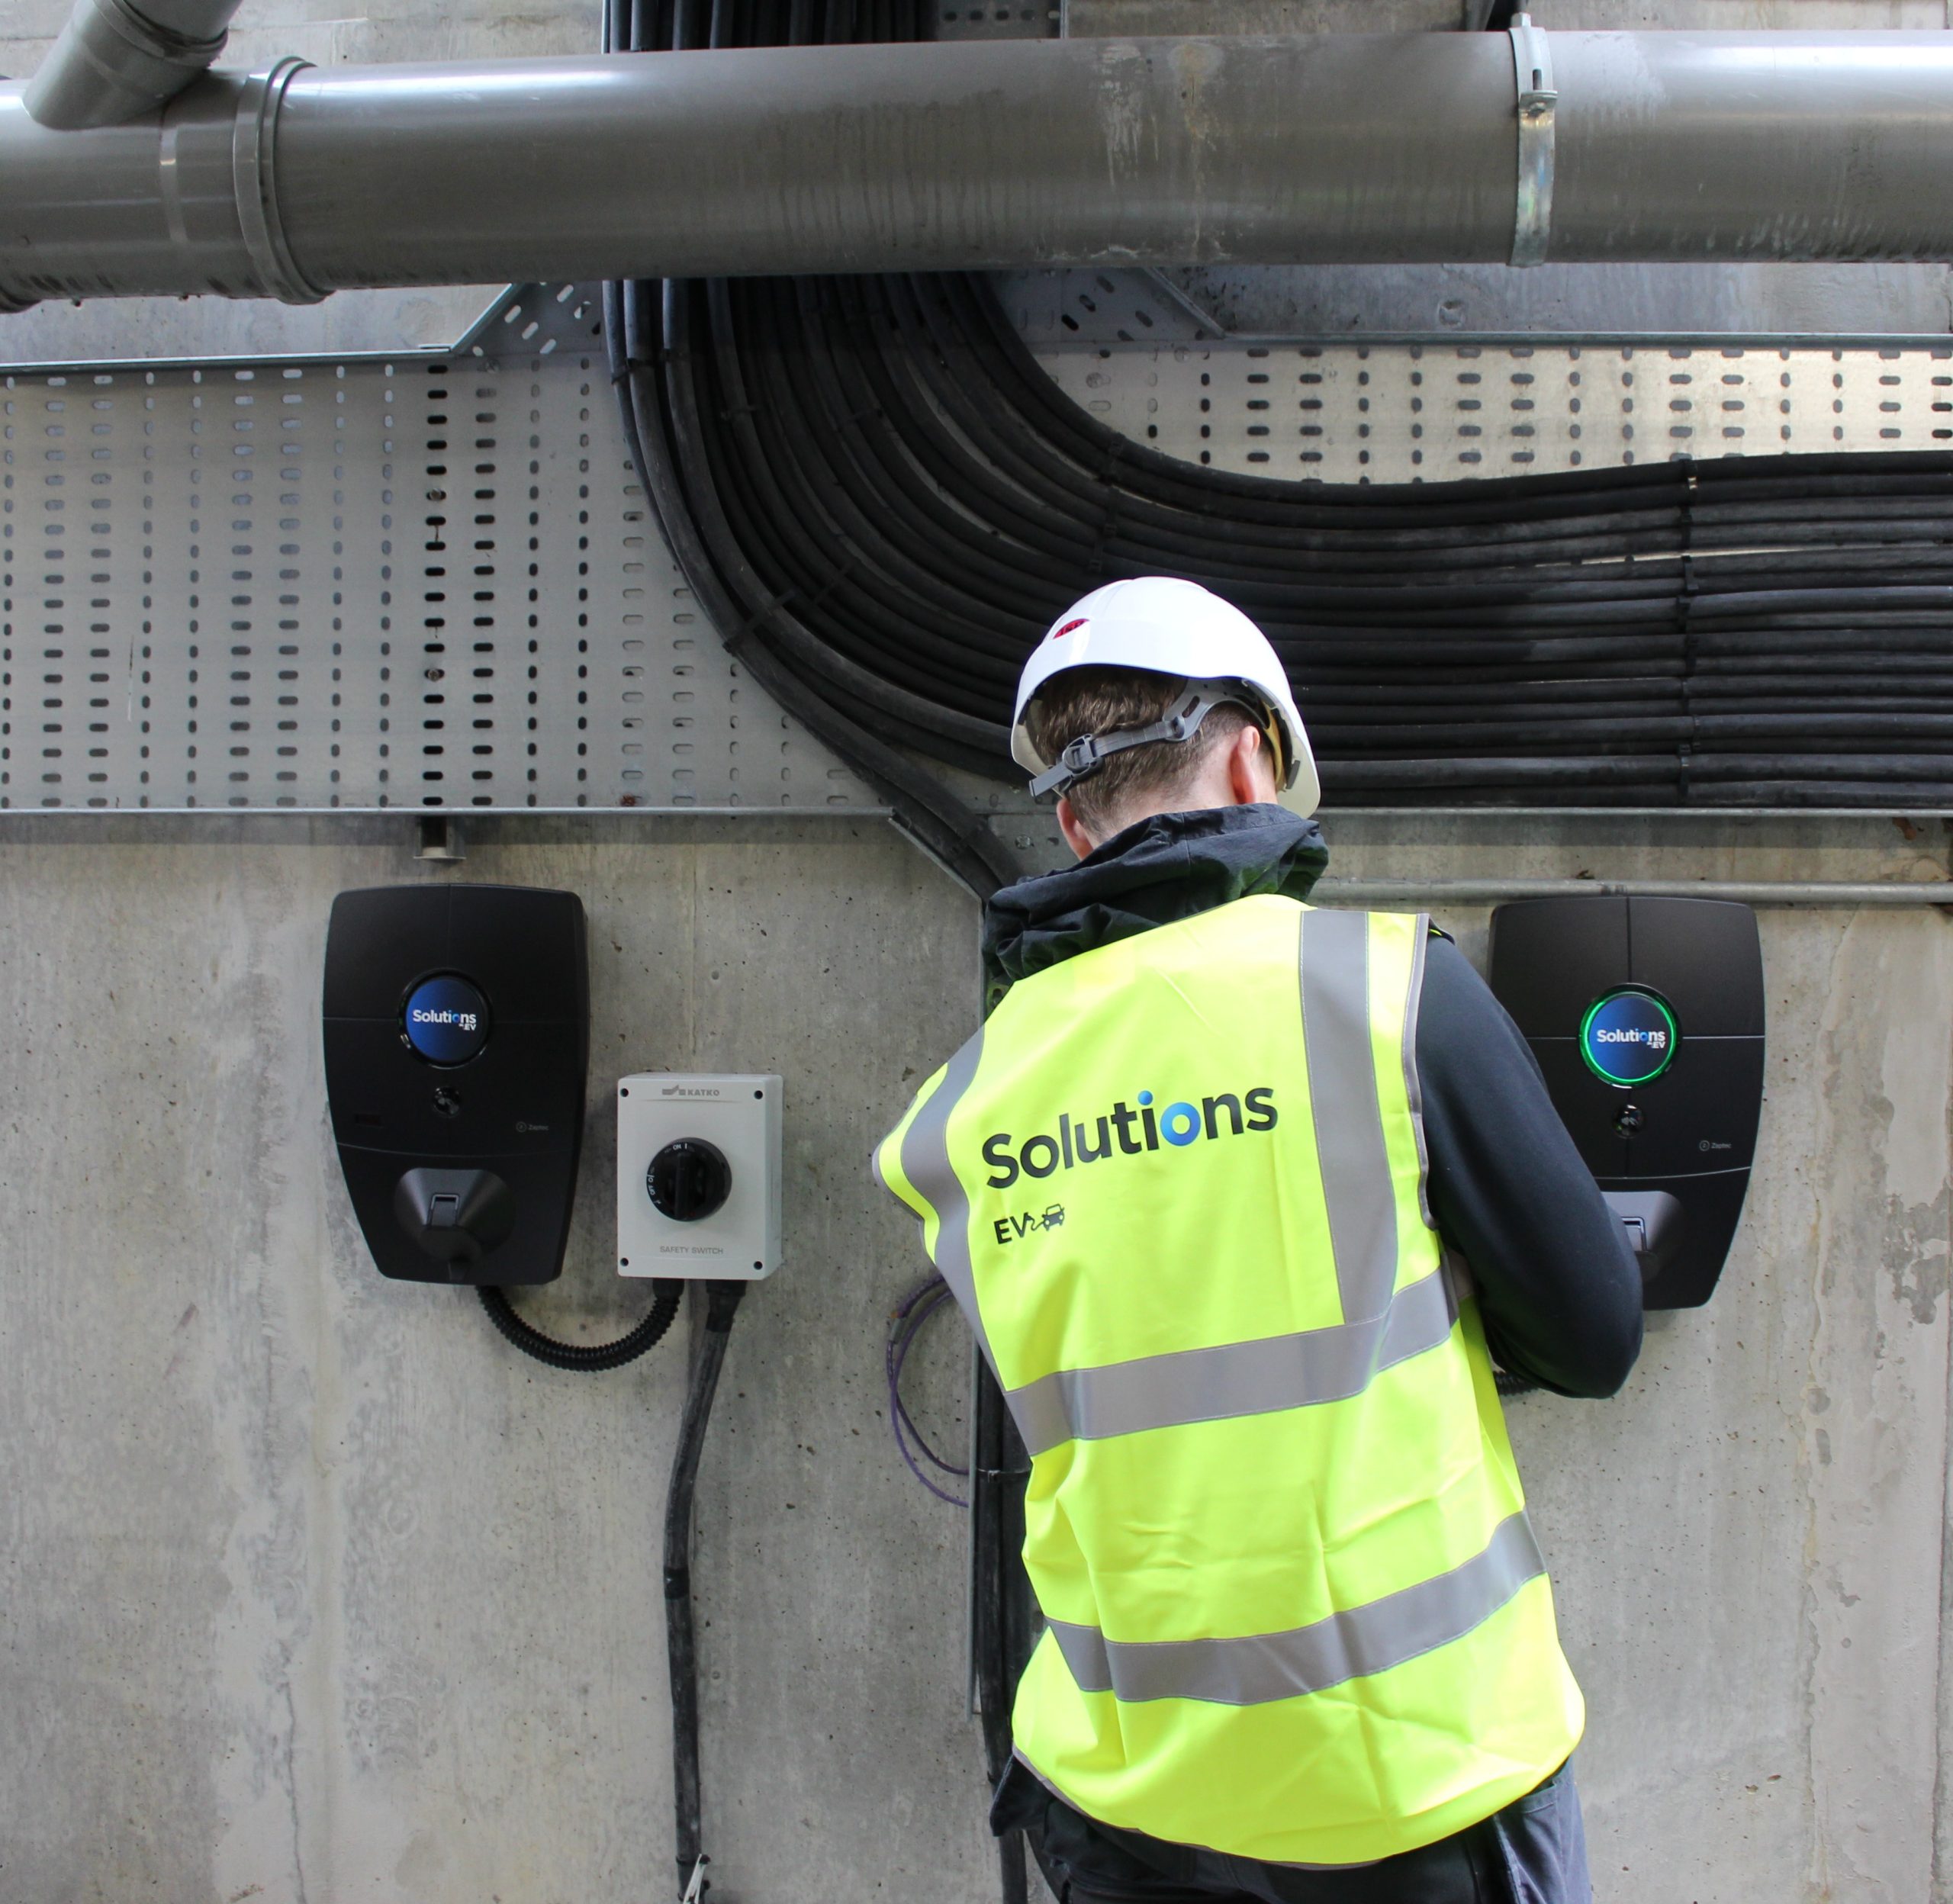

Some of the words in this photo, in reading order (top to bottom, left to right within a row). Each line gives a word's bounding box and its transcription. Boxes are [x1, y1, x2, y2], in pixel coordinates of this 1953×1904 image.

[413, 1009, 477, 1024] Solutions
[1597, 1028, 1665, 1042] Solutions
[982, 1087, 1279, 1189] Solutions
[993, 1212, 1028, 1245] EV
[691, 1246, 724, 1255] SWITCH
